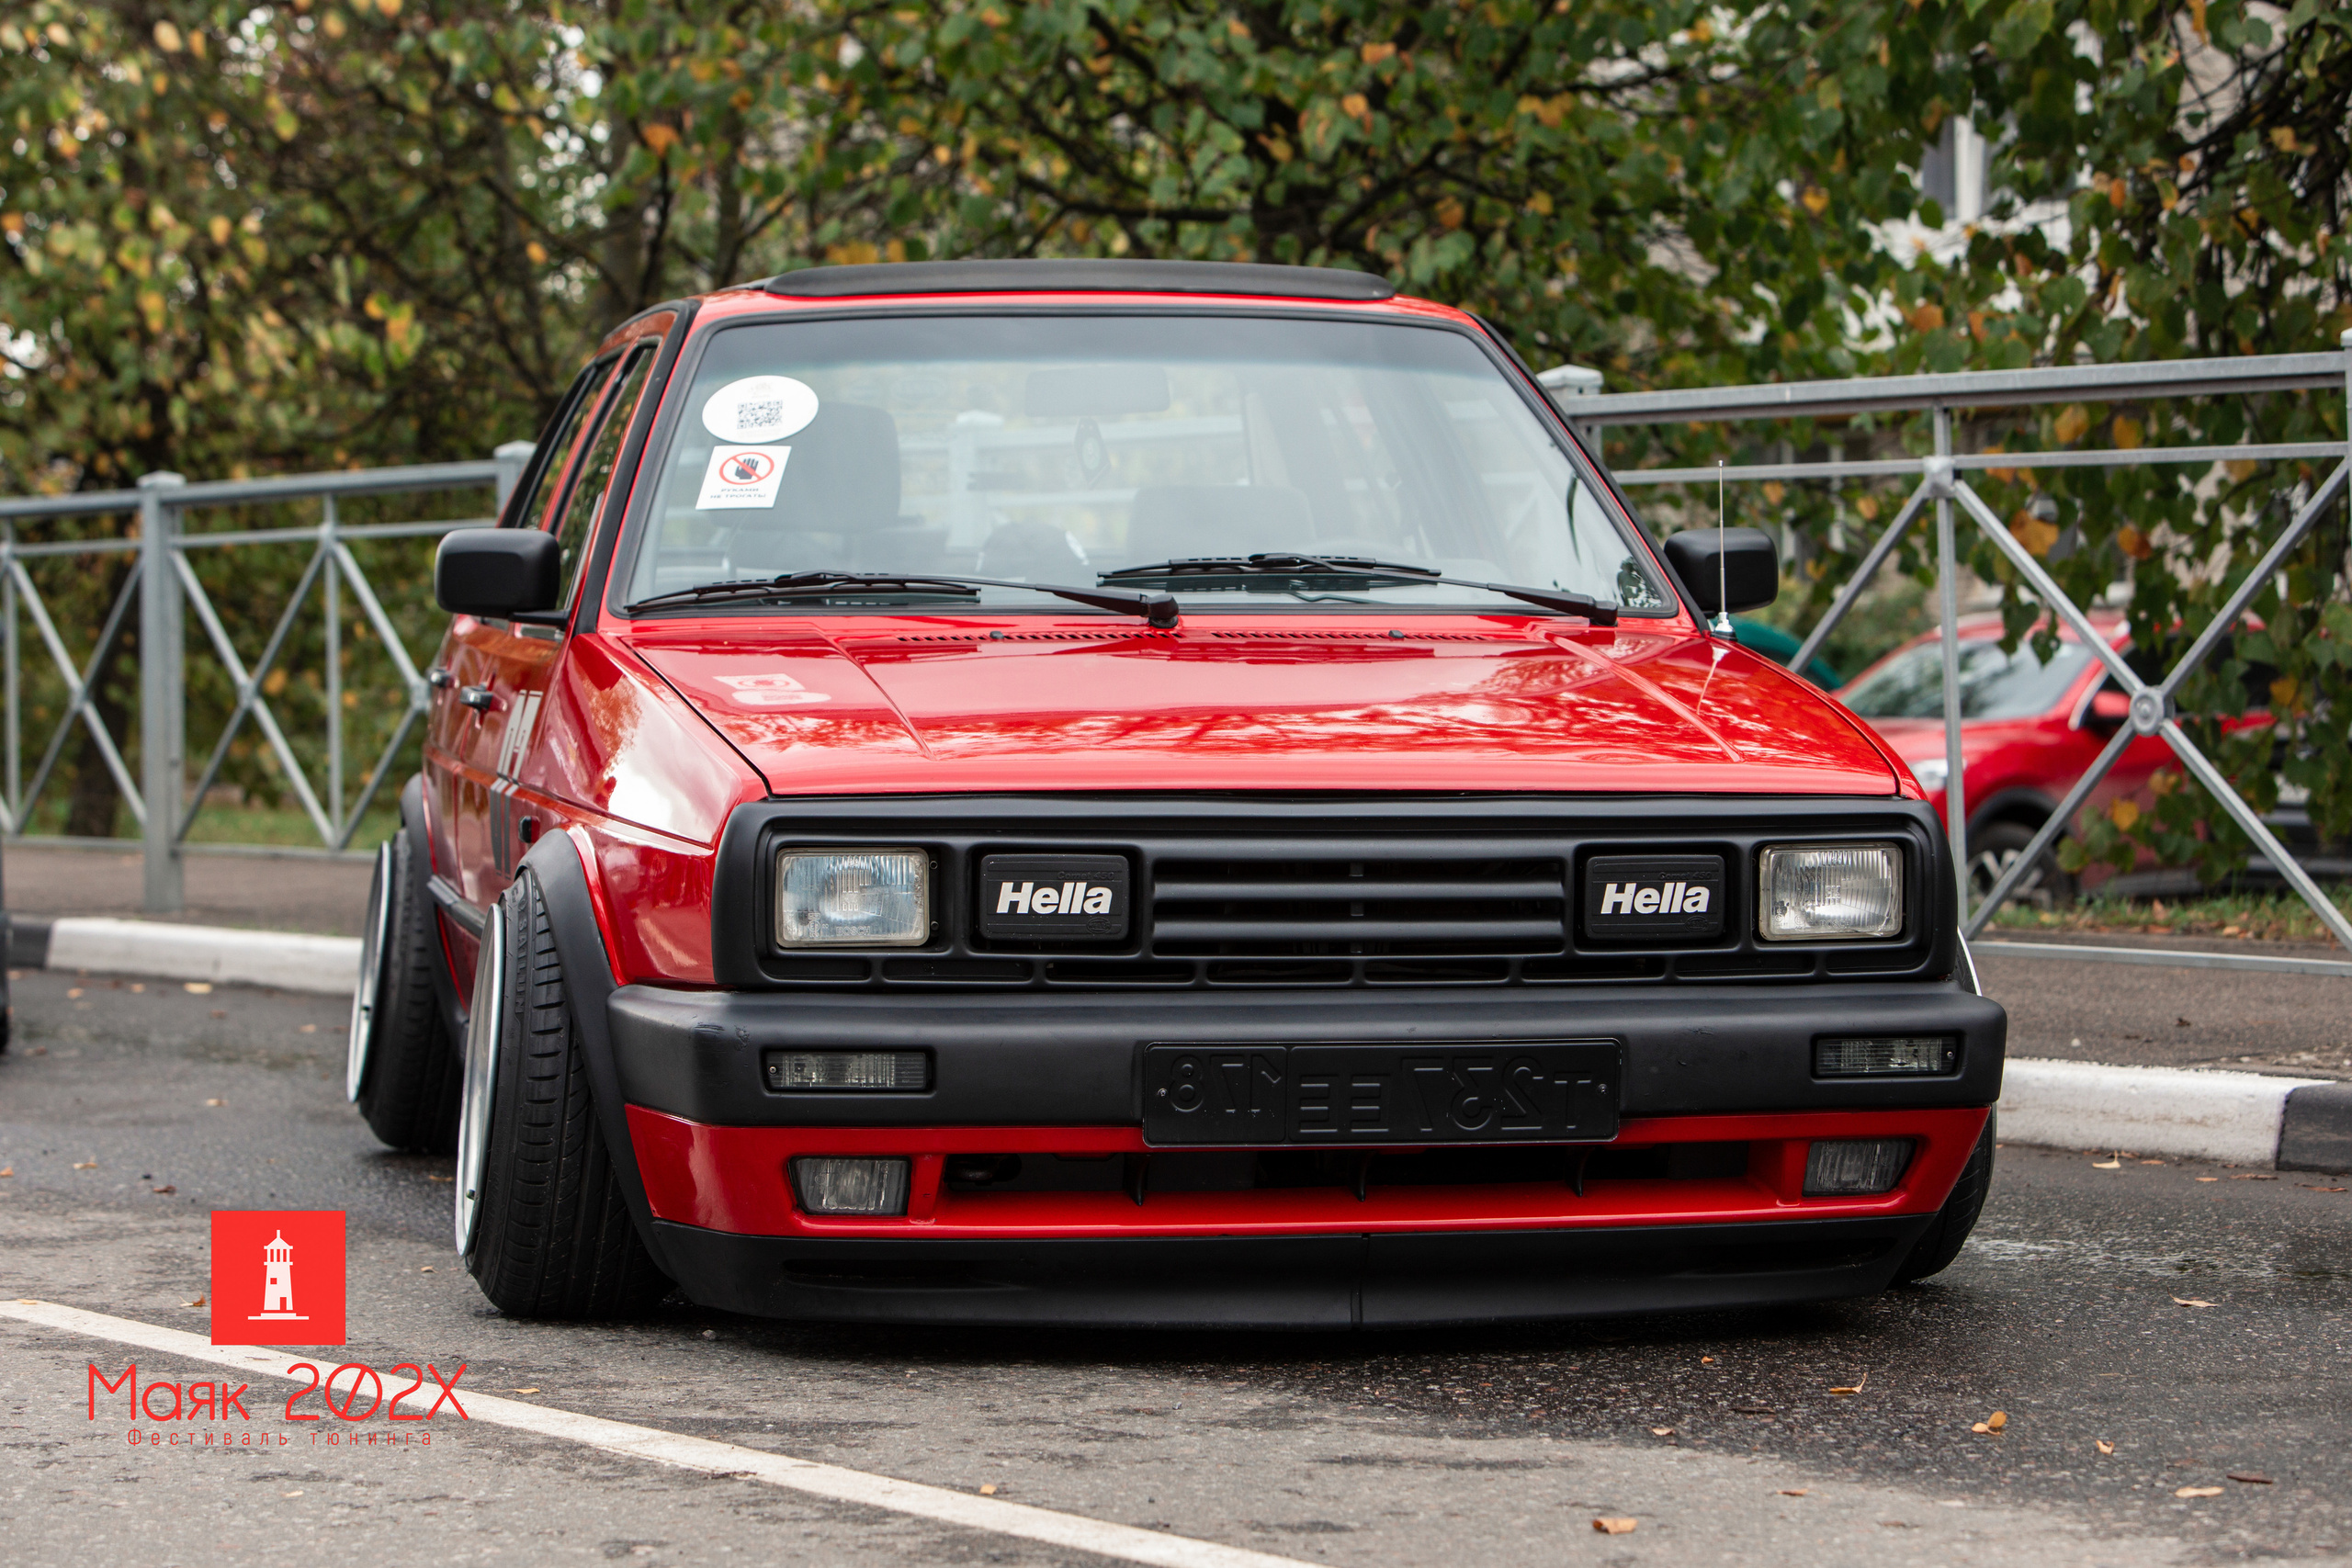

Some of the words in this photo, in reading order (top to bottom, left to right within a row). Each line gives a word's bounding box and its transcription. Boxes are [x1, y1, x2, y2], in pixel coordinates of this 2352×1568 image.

[996, 881, 1114, 915] Hella
[1600, 881, 1711, 915] Hella
[835, 926, 871, 936] BOSCH
